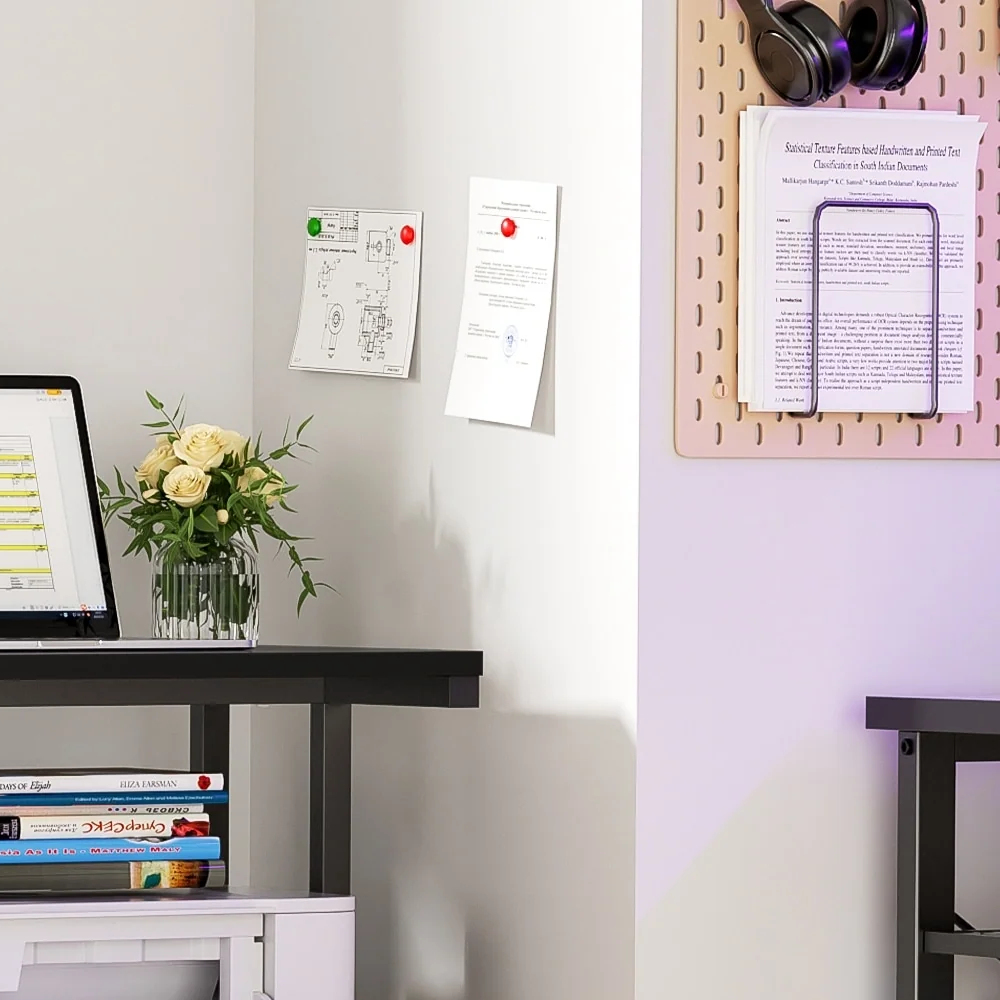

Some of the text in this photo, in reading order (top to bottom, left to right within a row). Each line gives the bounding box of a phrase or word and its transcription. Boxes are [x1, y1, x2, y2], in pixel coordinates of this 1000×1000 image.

[785, 141, 961, 158] Statistical Texture Features based Handwritten and Printed Text
[813, 159, 928, 172] Classification in South Indian Documents
[0, 783, 17, 791] DAYS
[30, 780, 52, 792] Elijah
[81, 818, 167, 835] СуперСЕКС
[25, 848, 43, 856] As
